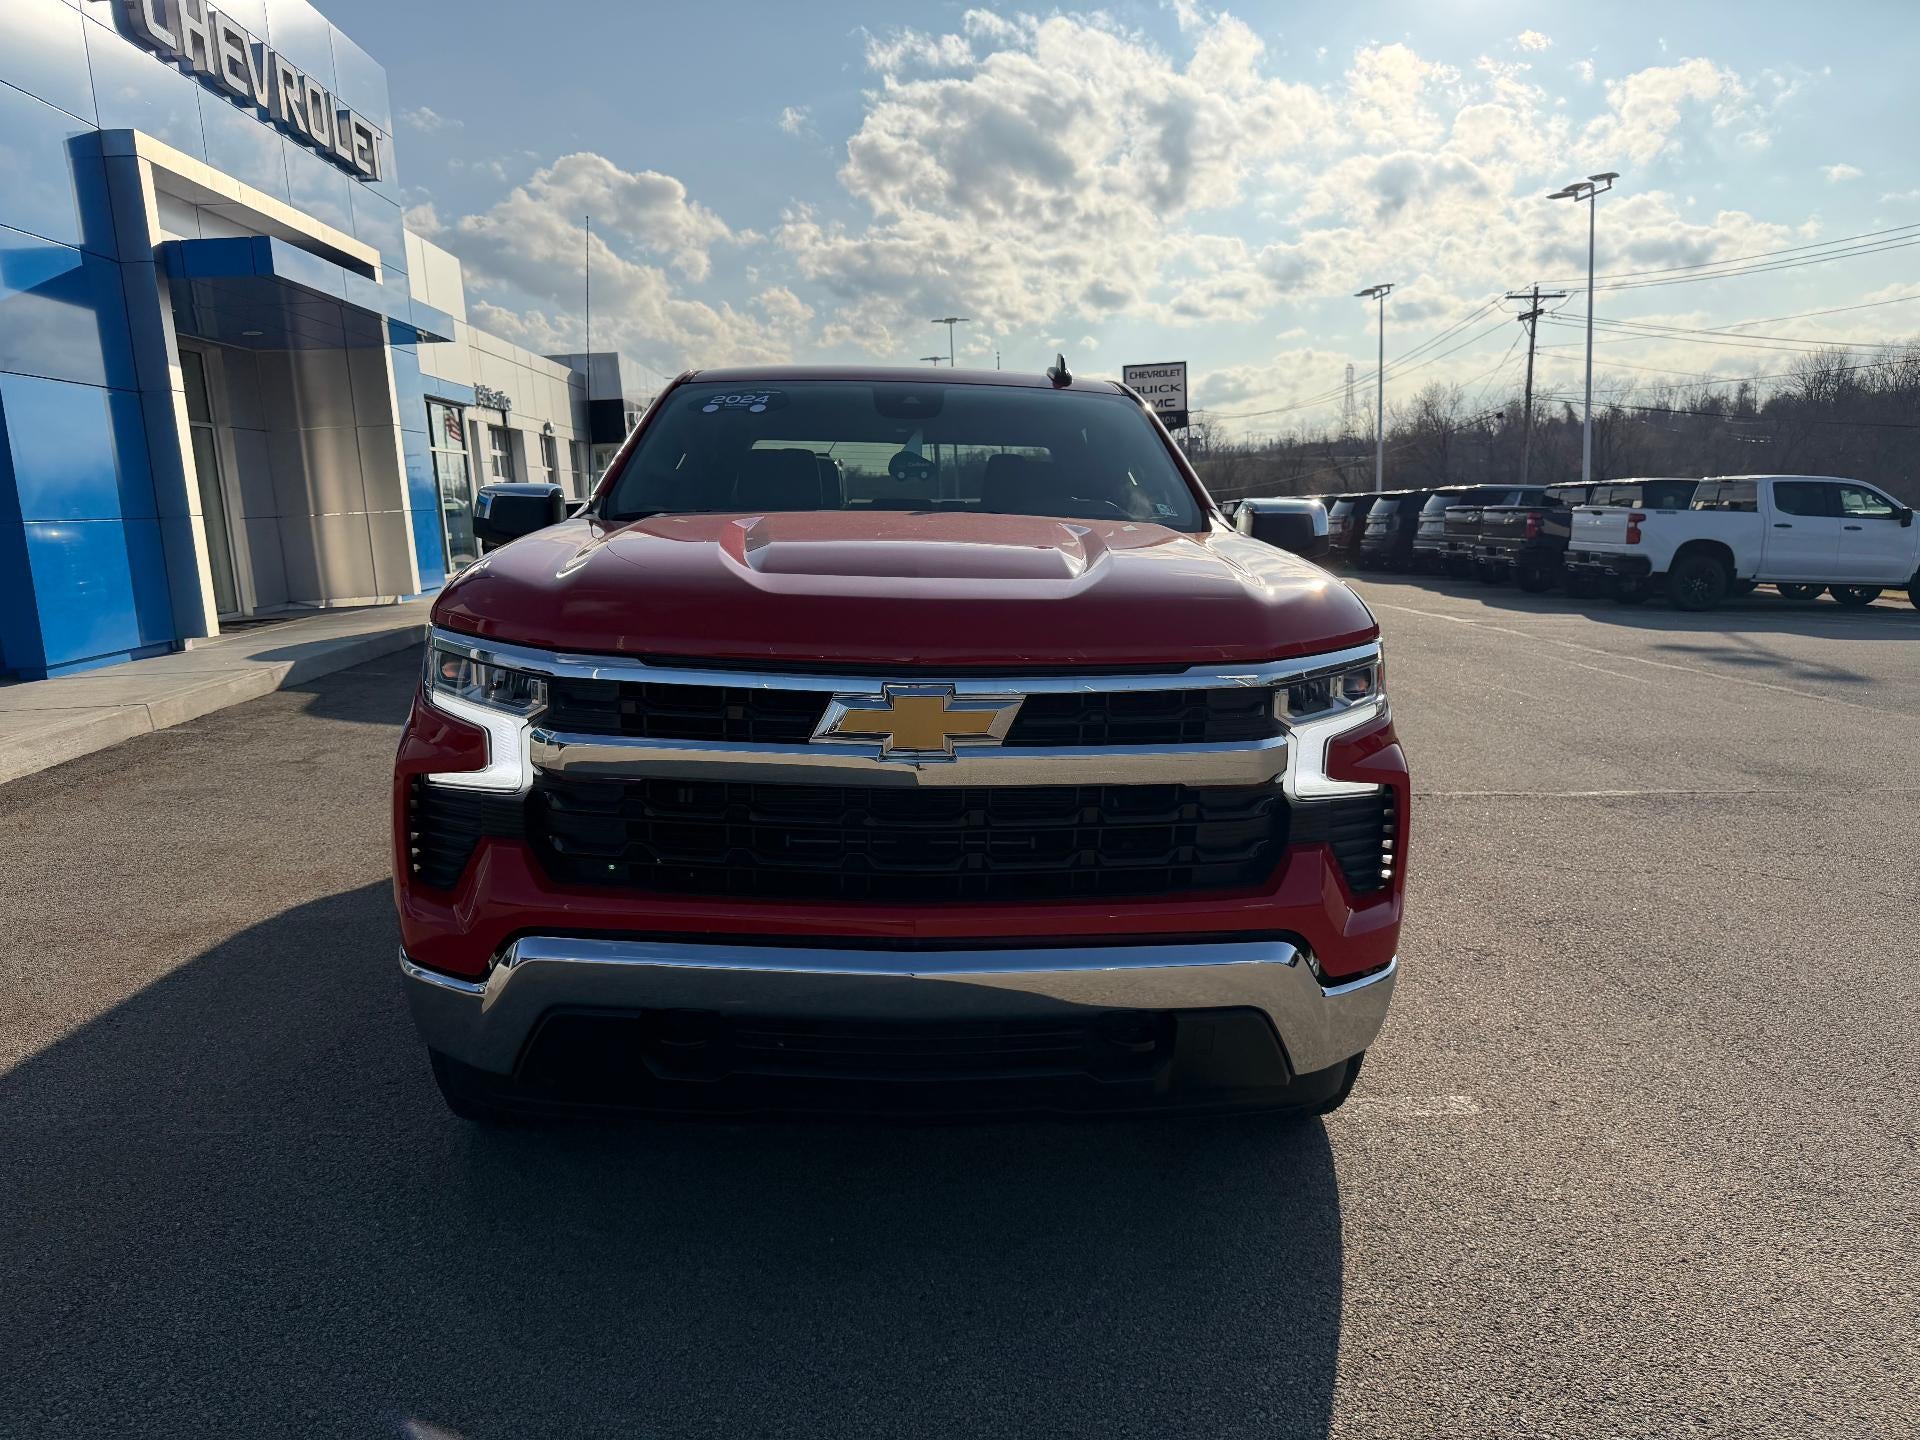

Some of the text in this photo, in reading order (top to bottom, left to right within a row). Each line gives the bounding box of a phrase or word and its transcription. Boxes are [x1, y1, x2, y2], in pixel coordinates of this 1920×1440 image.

[1129, 369, 1181, 379] CHEVROLET
[710, 395, 769, 403] 2024
[1146, 398, 1176, 408] MC
